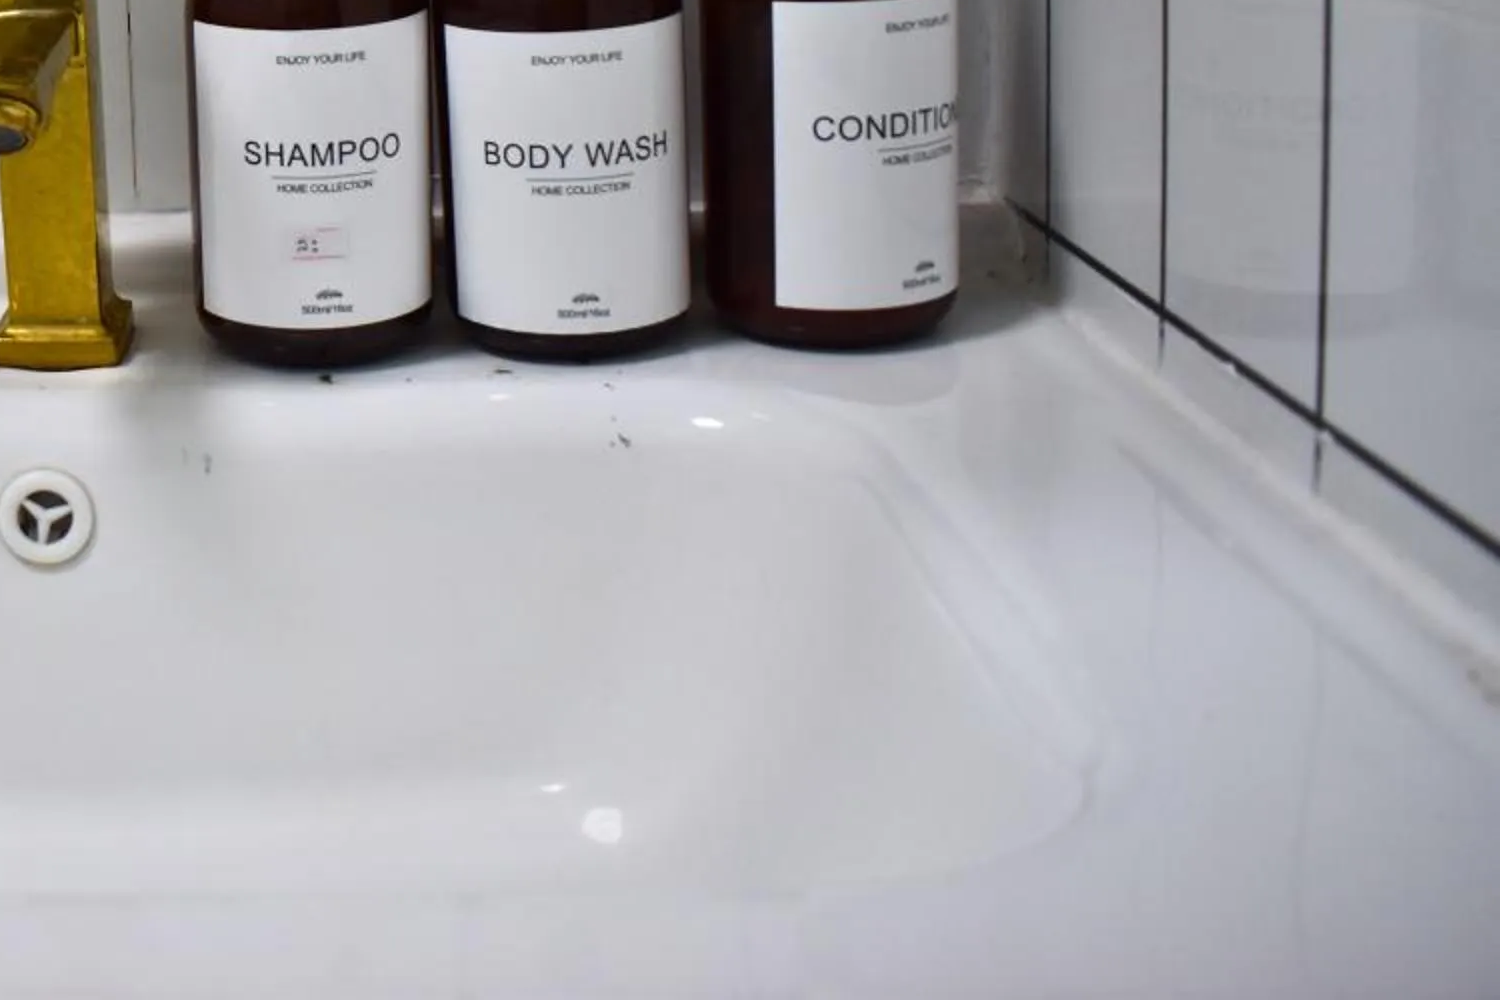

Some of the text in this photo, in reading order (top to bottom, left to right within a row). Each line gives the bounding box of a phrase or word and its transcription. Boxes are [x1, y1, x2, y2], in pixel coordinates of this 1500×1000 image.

[275, 50, 367, 66] ENJOY YOUR LIFE
[530, 50, 623, 67] ENJOY YOUR LIFE
[243, 131, 402, 169] SHAMPOO
[483, 128, 668, 170] BODY WASH
[881, 153, 911, 167] HOME
[276, 179, 374, 194] HOME COLLECTION
[531, 180, 631, 197] HOME COLLECTION
